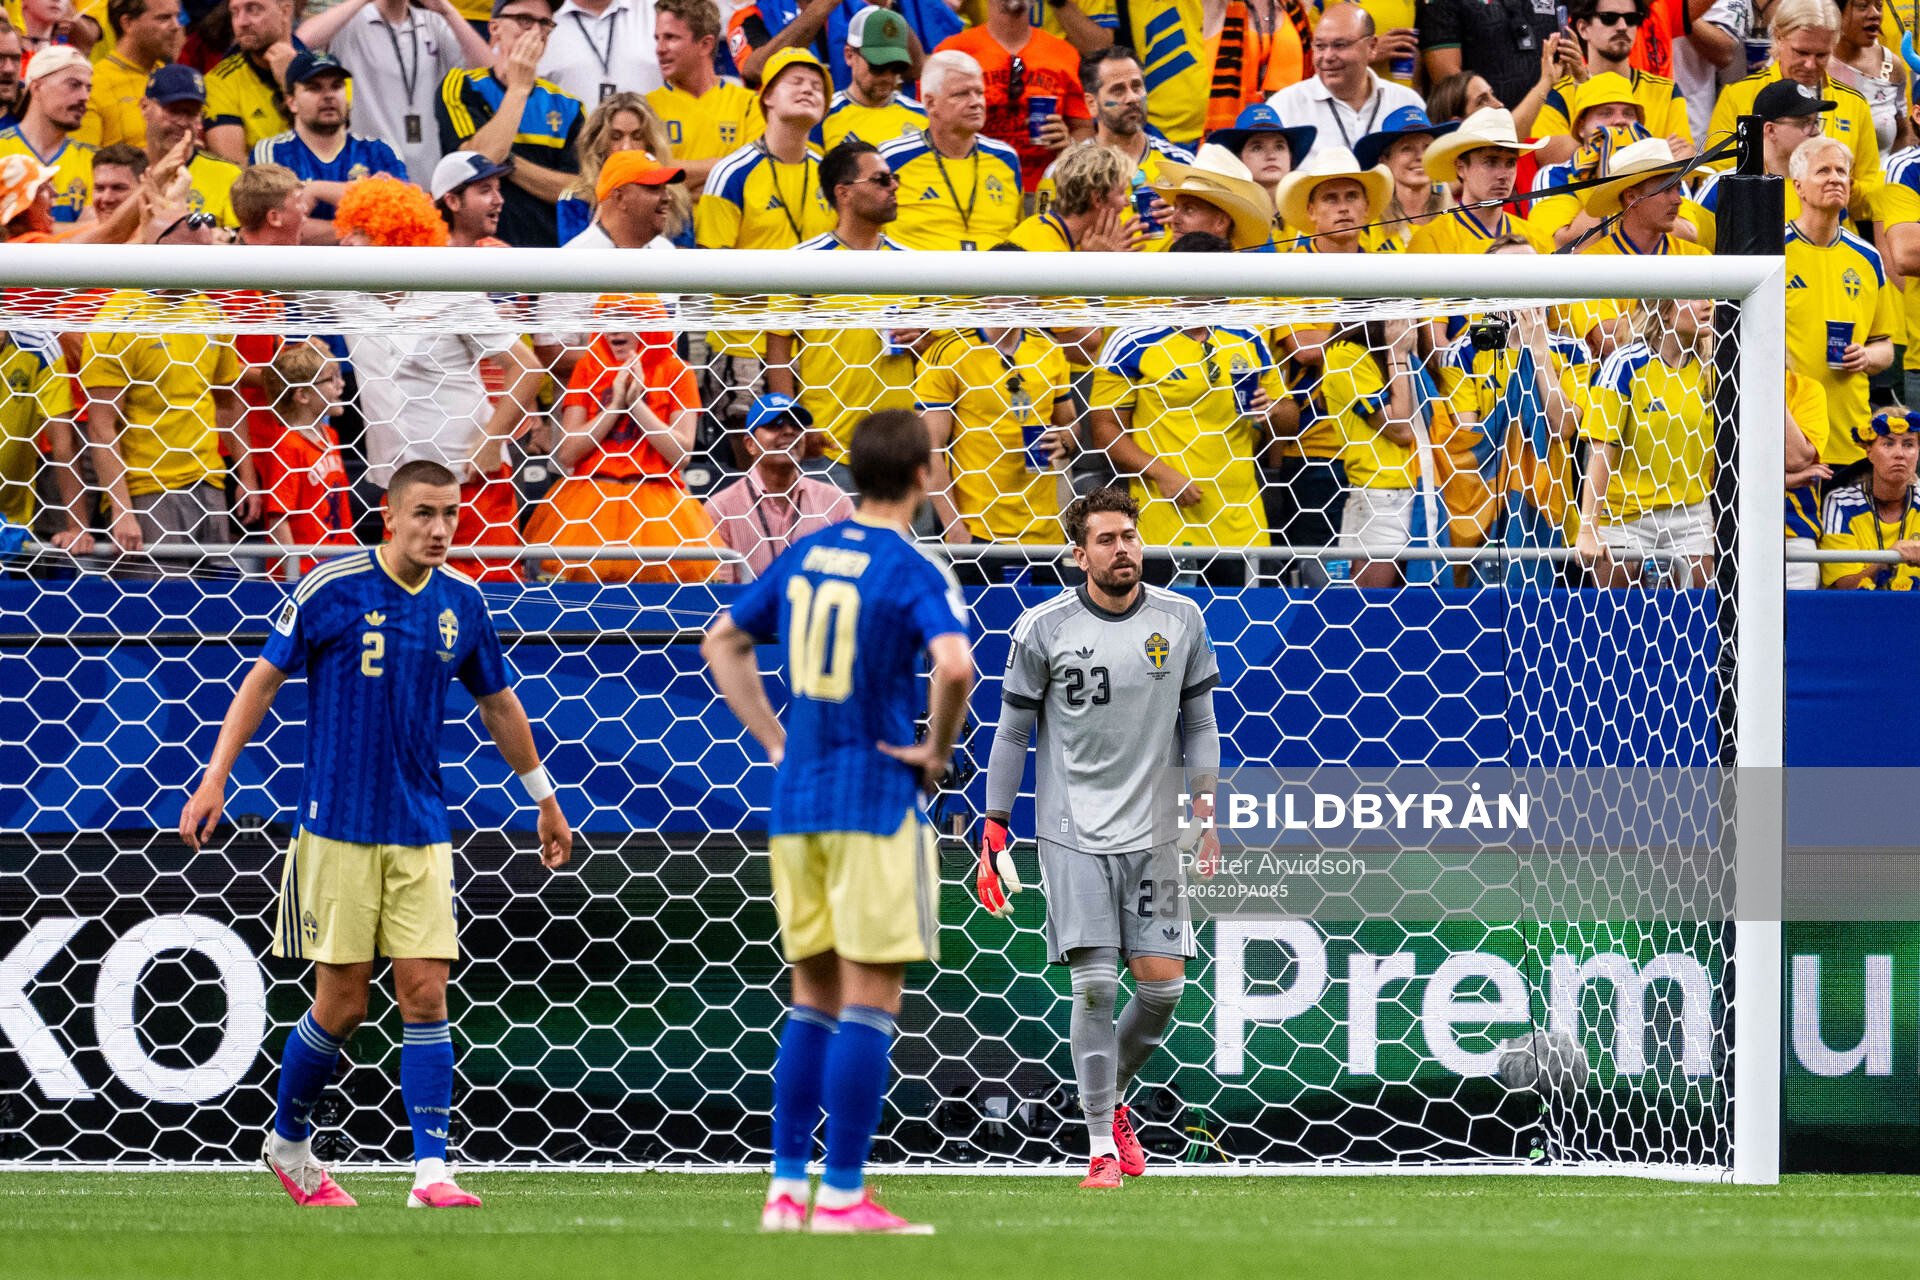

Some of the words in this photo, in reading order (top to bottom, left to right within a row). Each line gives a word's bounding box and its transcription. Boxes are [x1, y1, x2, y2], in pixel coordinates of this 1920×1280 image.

[361, 631, 385, 677] 2
[786, 574, 862, 704] 10
[1064, 666, 1110, 706] 23
[1138, 879, 1179, 918] 23
[1214, 917, 1893, 1077] Premu
